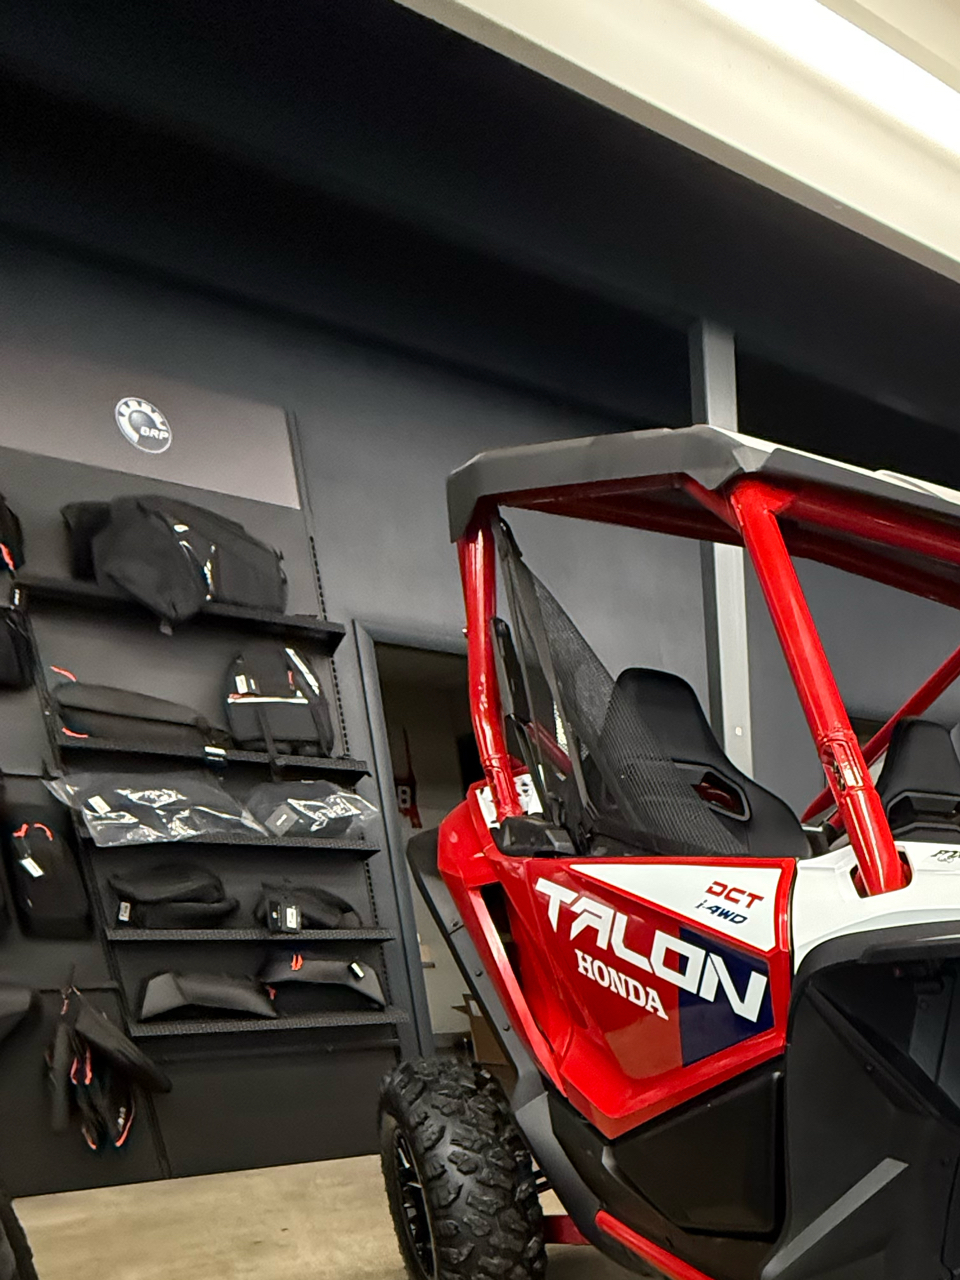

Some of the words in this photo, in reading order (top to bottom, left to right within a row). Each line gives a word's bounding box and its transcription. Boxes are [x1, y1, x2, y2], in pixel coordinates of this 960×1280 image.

[140, 426, 170, 440] BRP
[705, 880, 765, 909] DCT
[695, 899, 748, 925] i-4WD
[535, 877, 768, 1023] TALON
[574, 948, 669, 1021] HONDA
